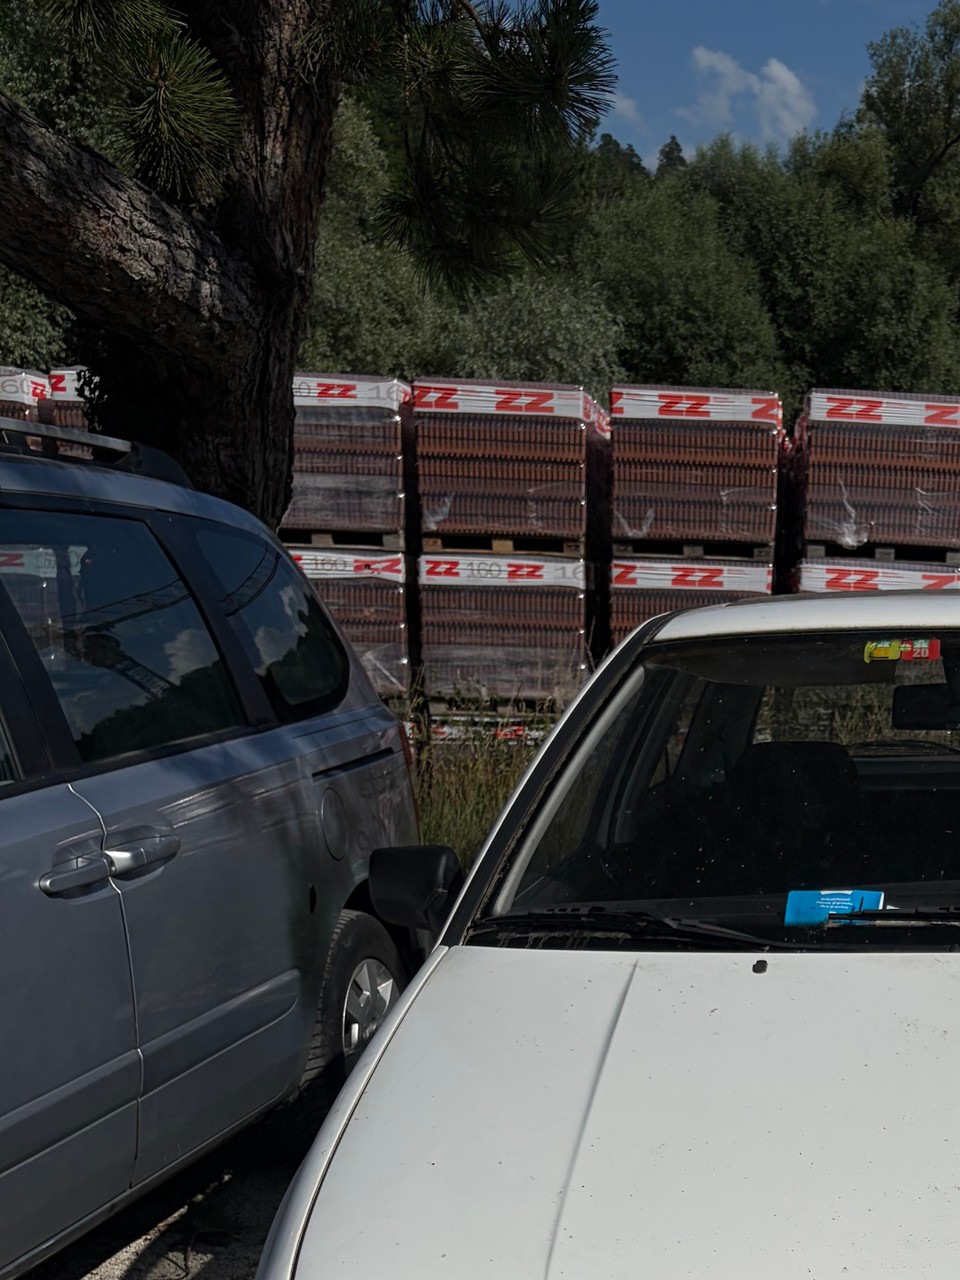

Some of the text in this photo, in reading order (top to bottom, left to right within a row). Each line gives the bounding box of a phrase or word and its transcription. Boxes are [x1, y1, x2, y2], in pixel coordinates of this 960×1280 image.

[47, 373, 67, 393] Z
[316, 382, 357, 399] ZZ
[413, 385, 459, 409] ZZ
[495, 389, 555, 413] ZZ
[658, 394, 778, 420] ZZ Z
[825, 396, 882, 421] ZZ
[353, 558, 402, 575] ZZ
[425, 560, 460, 577] ZZ
[467, 562, 501, 577] 160
[506, 563, 544, 580] ZZ
[612, 563, 724, 587] Z ZZ
[825, 568, 879, 591] ZZ
[912, 648, 929, 658] 20
